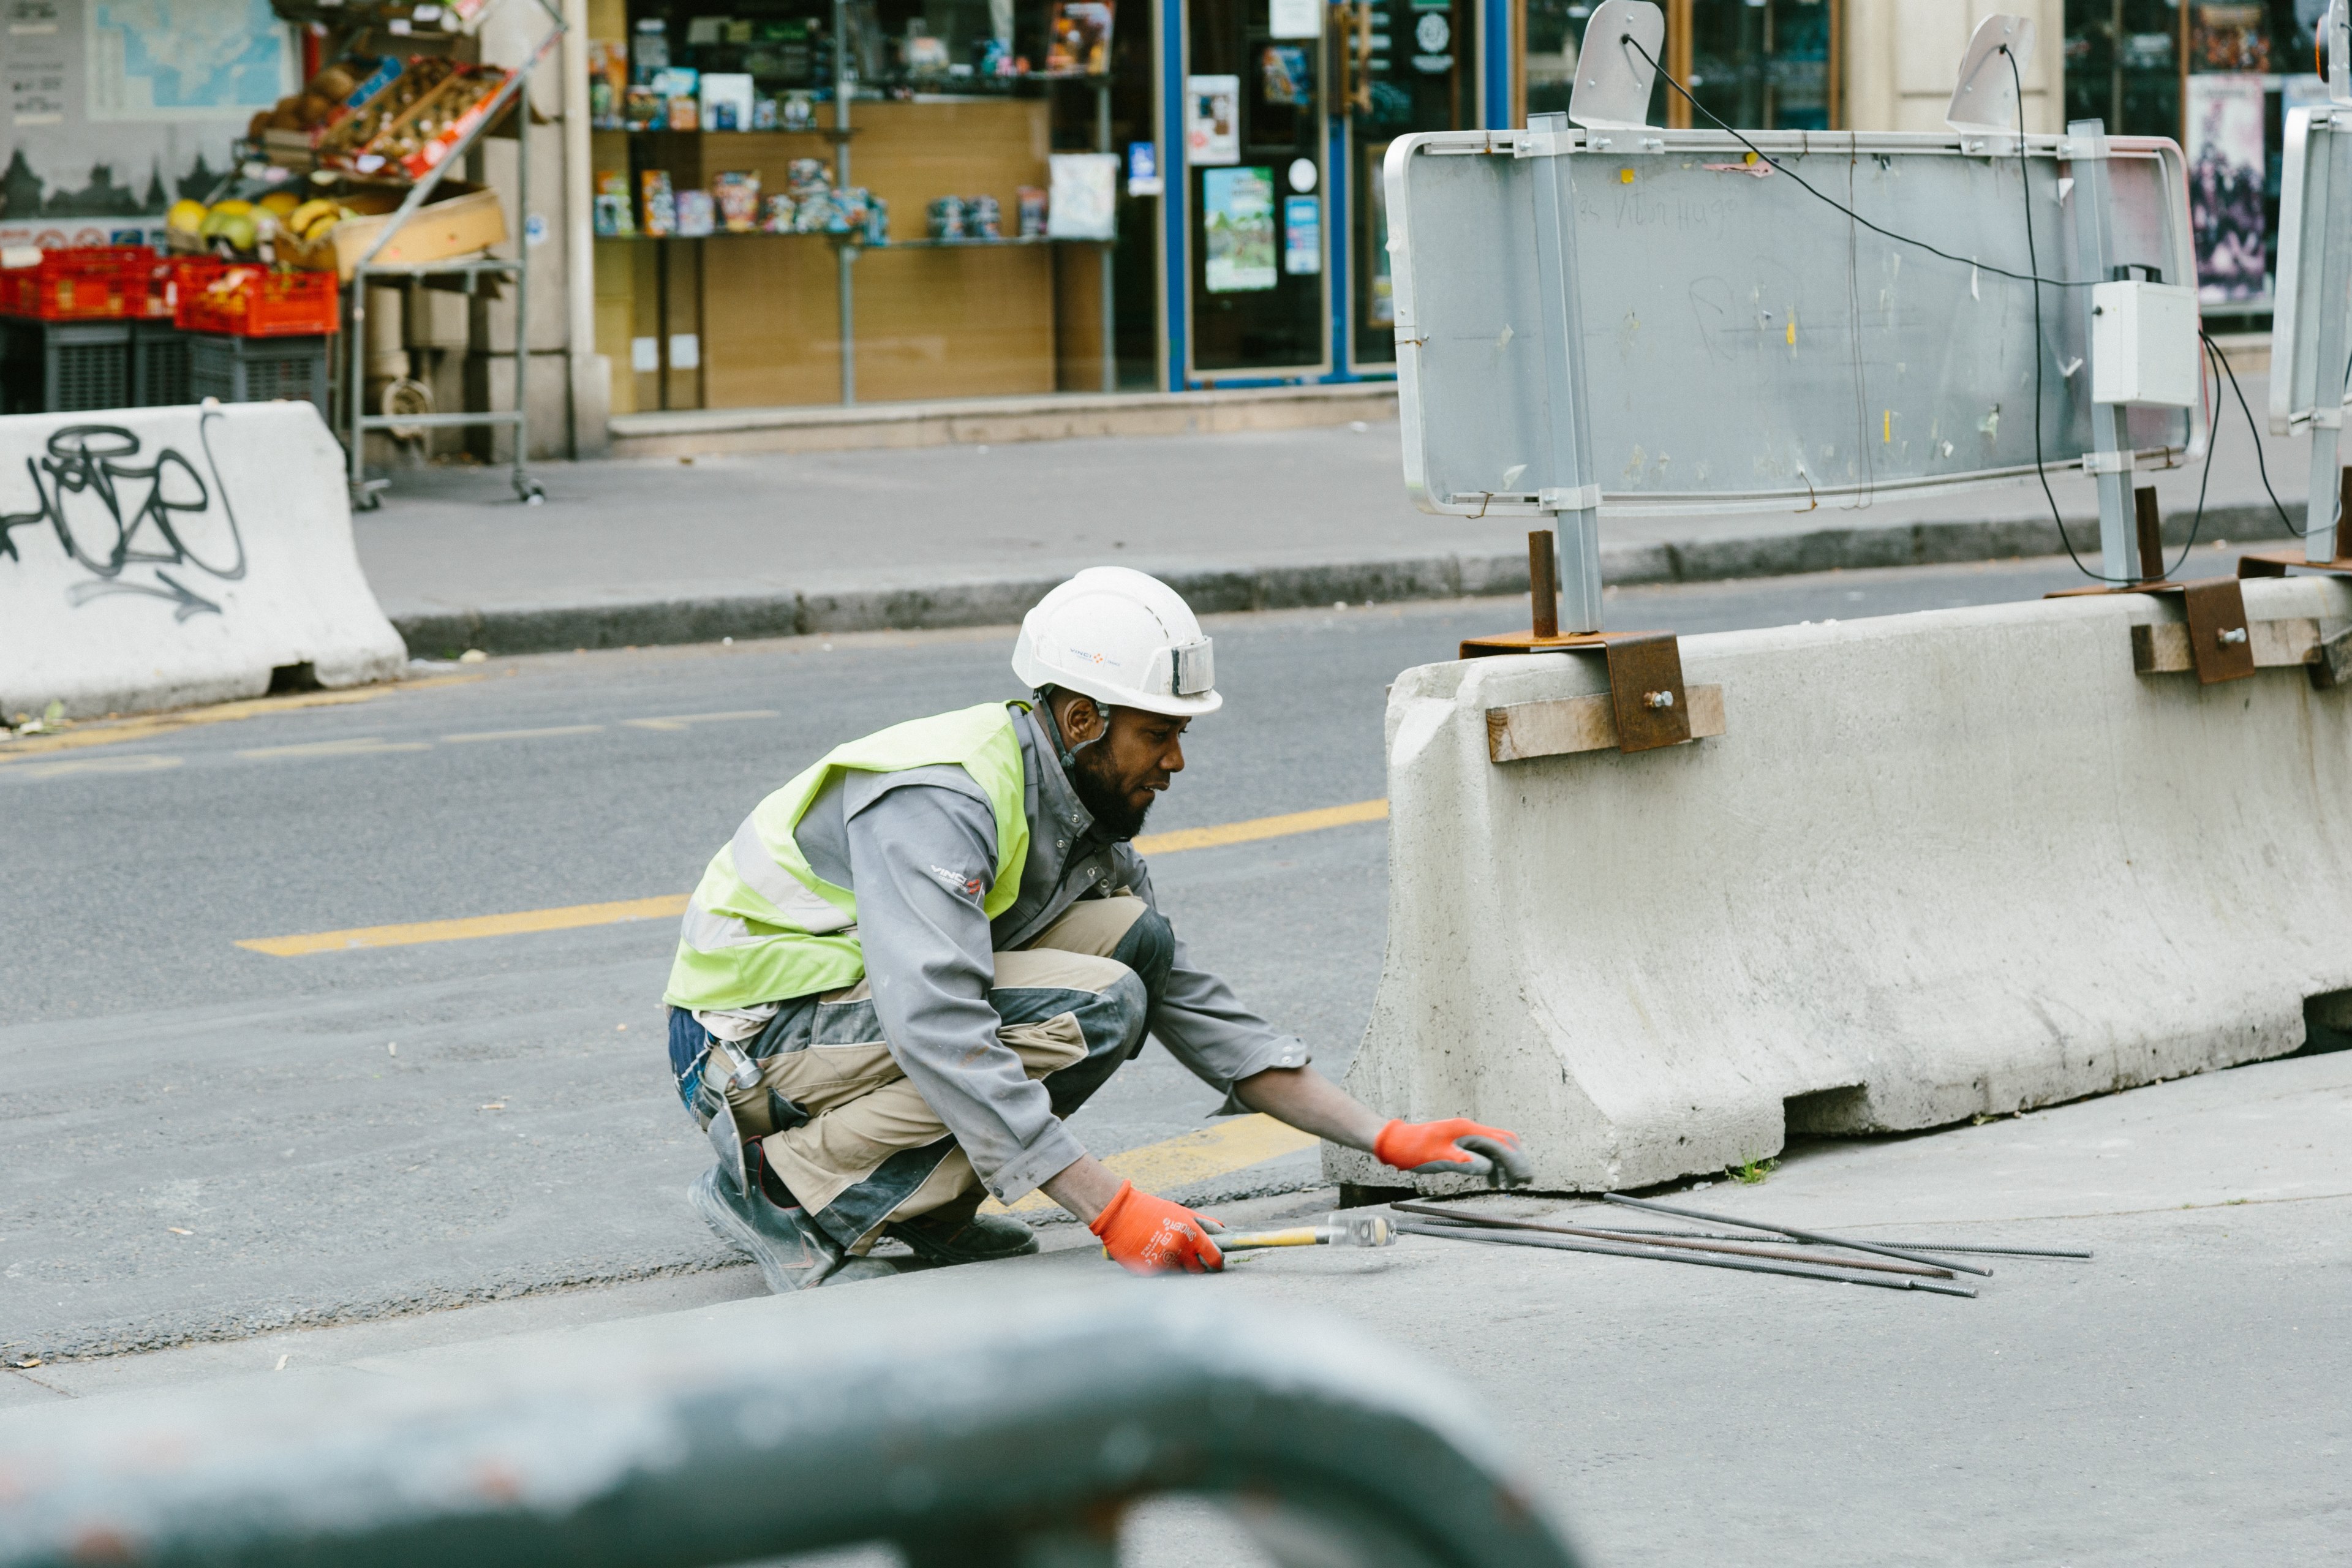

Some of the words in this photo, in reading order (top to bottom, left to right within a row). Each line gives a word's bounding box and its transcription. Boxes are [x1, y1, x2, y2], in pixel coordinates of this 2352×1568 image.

[1069, 647, 1091, 658] VINCI
[930, 864, 968, 885] VINCI
[1169, 1221, 1197, 1242] SINGER
